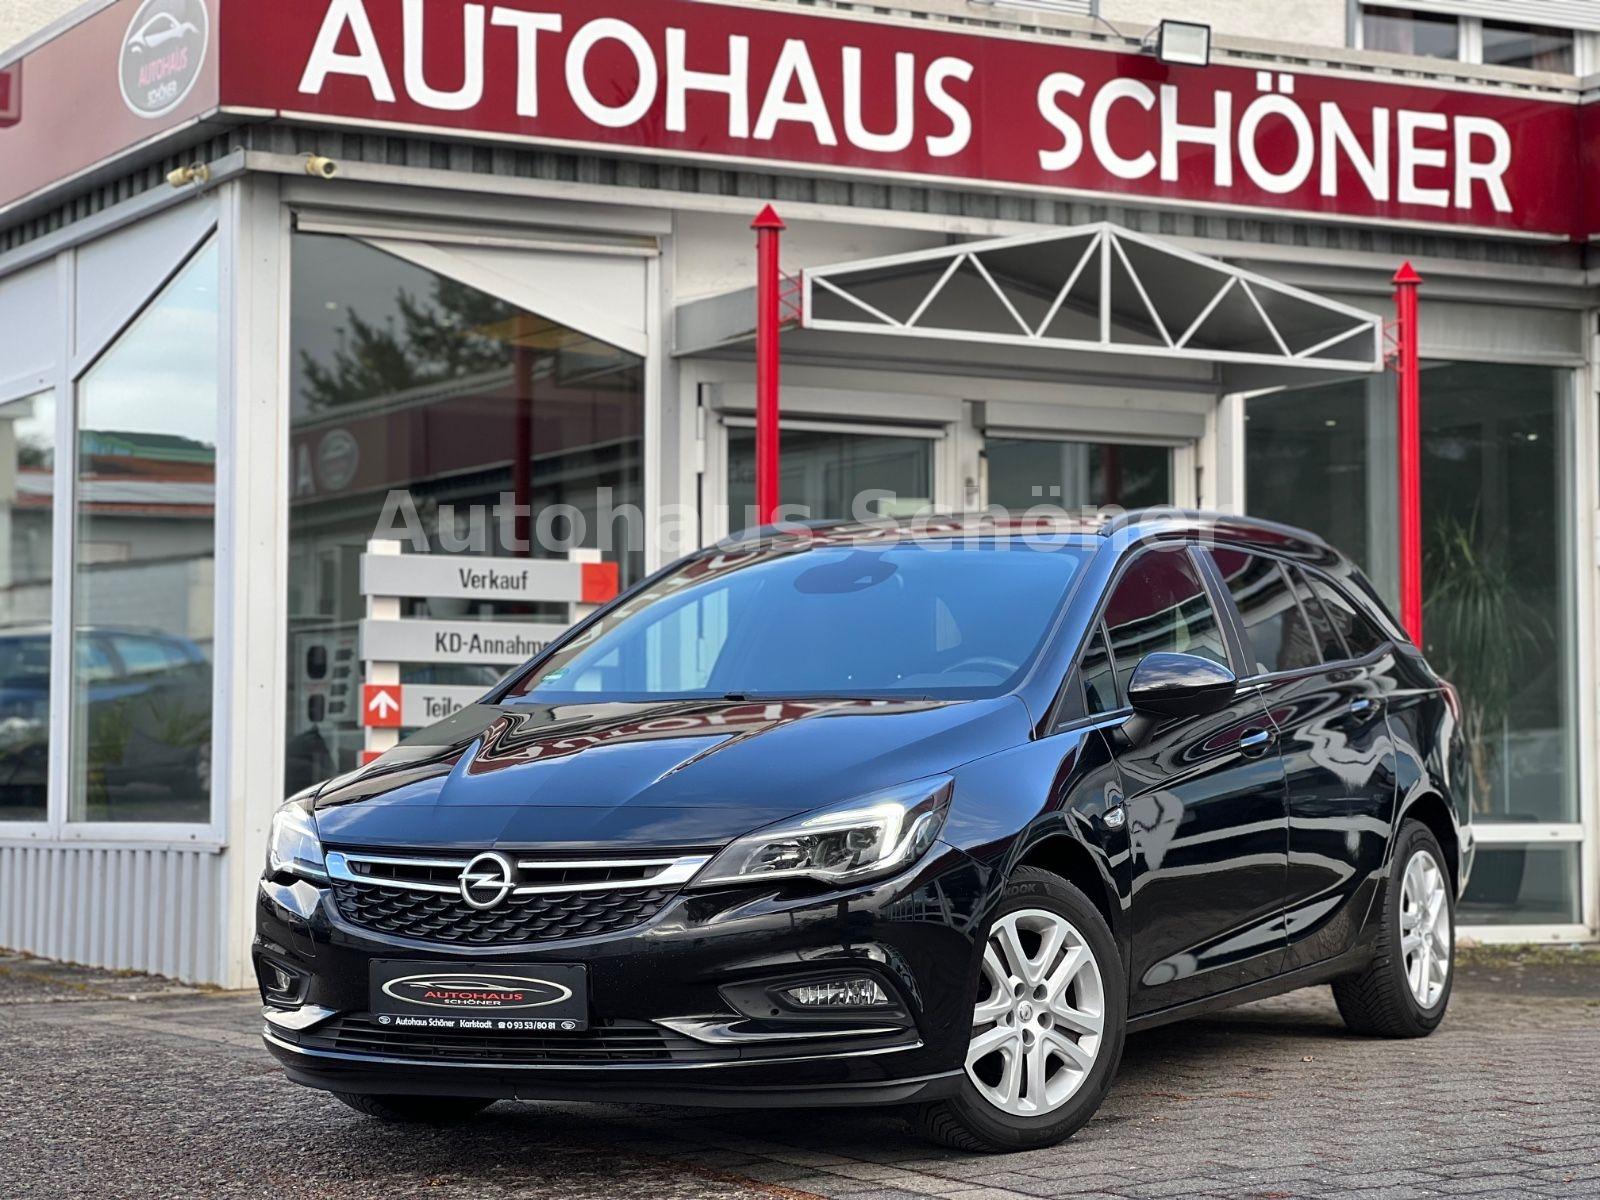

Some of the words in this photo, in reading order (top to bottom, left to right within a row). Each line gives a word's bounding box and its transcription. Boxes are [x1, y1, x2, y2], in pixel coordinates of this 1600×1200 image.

[138, 48, 188, 87] AUTOHAUS
[299, 0, 974, 157] AUTOHAUS
[1038, 72, 1512, 212] SCHÖNER
[459, 568, 528, 590] Verkauf
[424, 991, 523, 1001] AUTOHAUS
[395, 1016, 427, 1026] Autohaus
[428, 1017, 455, 1027] Schöner
[460, 1019, 492, 1029] Karlstadt
